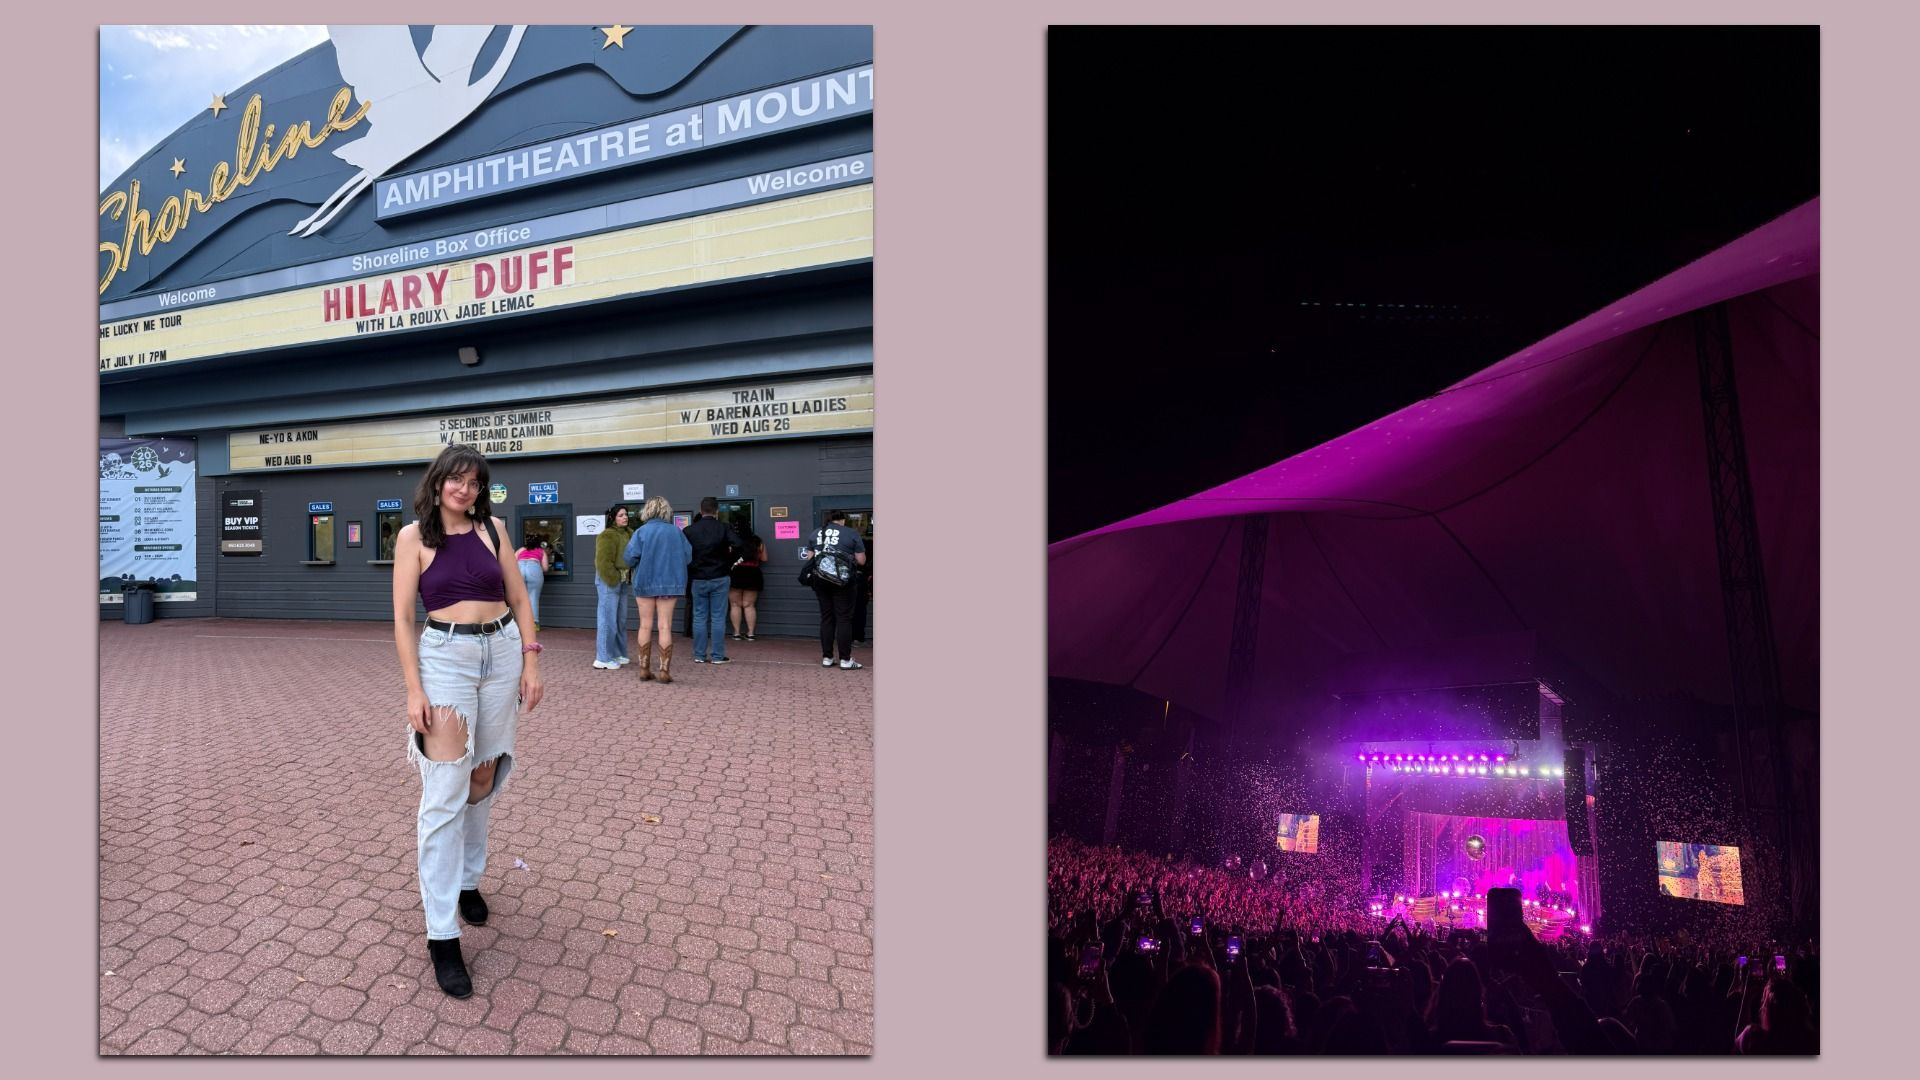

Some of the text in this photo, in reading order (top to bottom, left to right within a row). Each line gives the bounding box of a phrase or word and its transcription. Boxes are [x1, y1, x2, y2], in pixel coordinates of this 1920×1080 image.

[383, 123, 651, 209] AMPHITHEATRE
[664, 114, 704, 147] at
[747, 159, 865, 195] Welcome
[351, 226, 532, 273] Shoreline Box Office
[323, 245, 574, 323] HILARY DUFF
[159, 286, 216, 306] Welcome
[356, 317, 385, 333] WITH
[389, 314, 404, 329] LA
[455, 299, 487, 320] JADE
[491, 294, 535, 314] LEMAC
[113, 321, 139, 337] LUCKY
[143, 318, 156, 333] ME
[159, 314, 182, 329] TOUR
[114, 354, 134, 368] JULY
[138, 352, 145, 365] 11
[149, 349, 167, 363] 7PM
[732, 387, 775, 404] TRAIN
[706, 402, 789, 422] BARENAKED
[792, 397, 847, 415] LADIES
[439, 410, 552, 431] 5 SECONDS OF SUMMER
[711, 417, 790, 437] WED AUG 26
[259, 429, 319, 445] NE-YO & AKON
[459, 429, 479, 442] THE
[480, 428, 509, 440] BAND
[511, 423, 554, 438] CAMINO
[138, 452, 151, 461] 20
[485, 441, 507, 454] AUG
[509, 440, 523, 452] 28
[138, 460, 153, 469] 26
[264, 454, 312, 467] WED AUG 19
[534, 494, 552, 503] M-Z
[224, 516, 259, 526] BUY VIP
